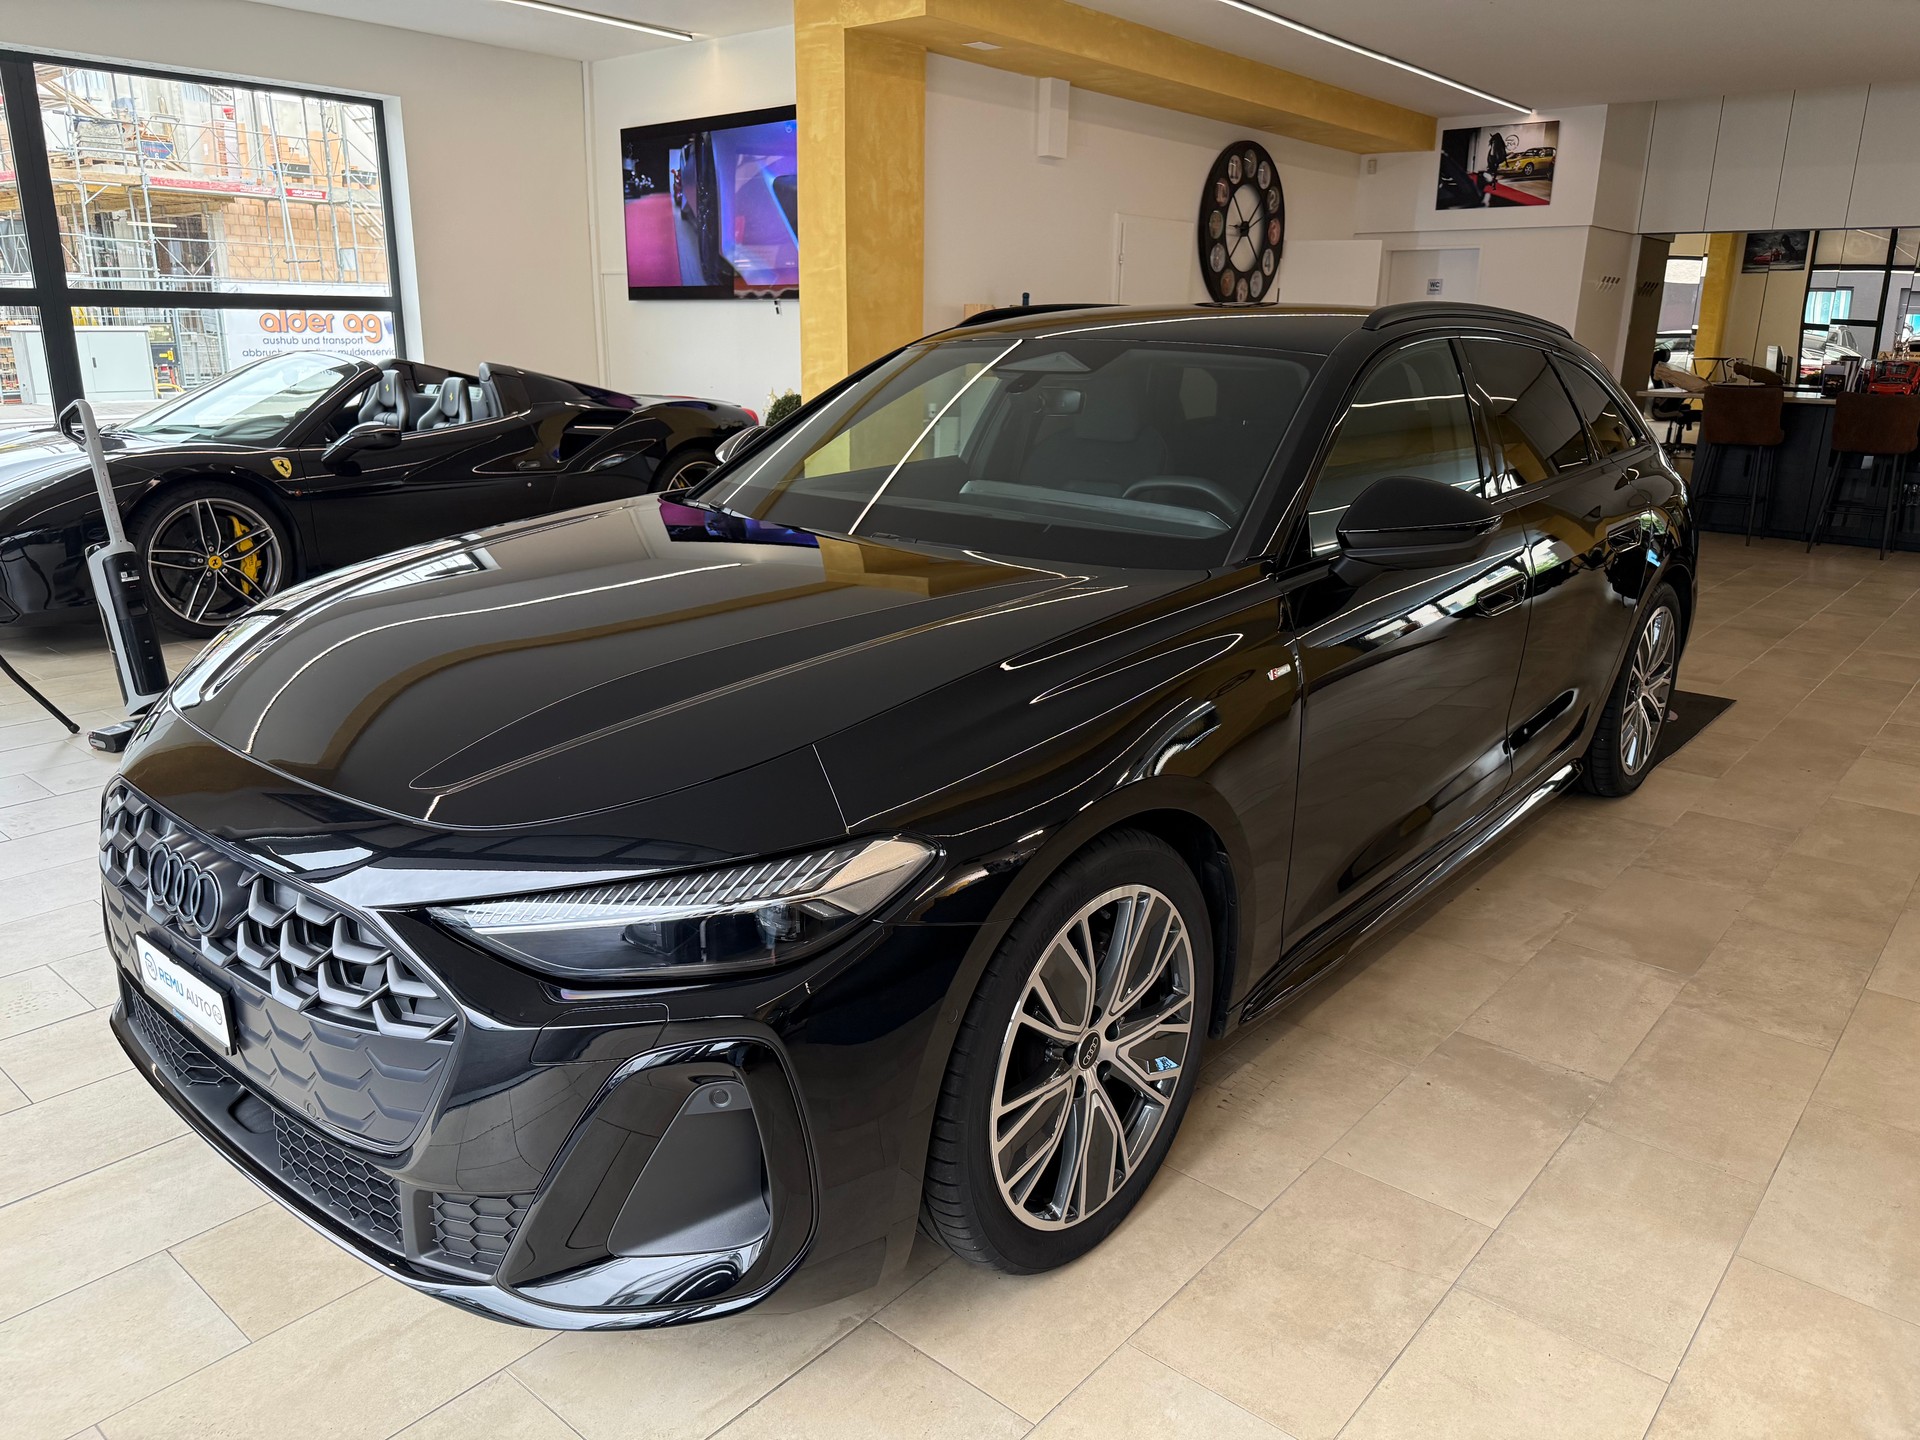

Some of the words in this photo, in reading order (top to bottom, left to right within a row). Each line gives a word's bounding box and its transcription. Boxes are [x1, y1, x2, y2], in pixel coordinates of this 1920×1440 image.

[1268, 189, 1277, 213] 2
[1270, 221, 1278, 243] 3
[1264, 250, 1271, 273] 4
[259, 310, 335, 333] alder
[343, 313, 383, 343] ag
[262, 336, 299, 345] aushub
[301, 336, 320, 345] und
[322, 336, 364, 347] transport
[158, 966, 184, 997] REMU
[186, 987, 212, 1017] AUTO
